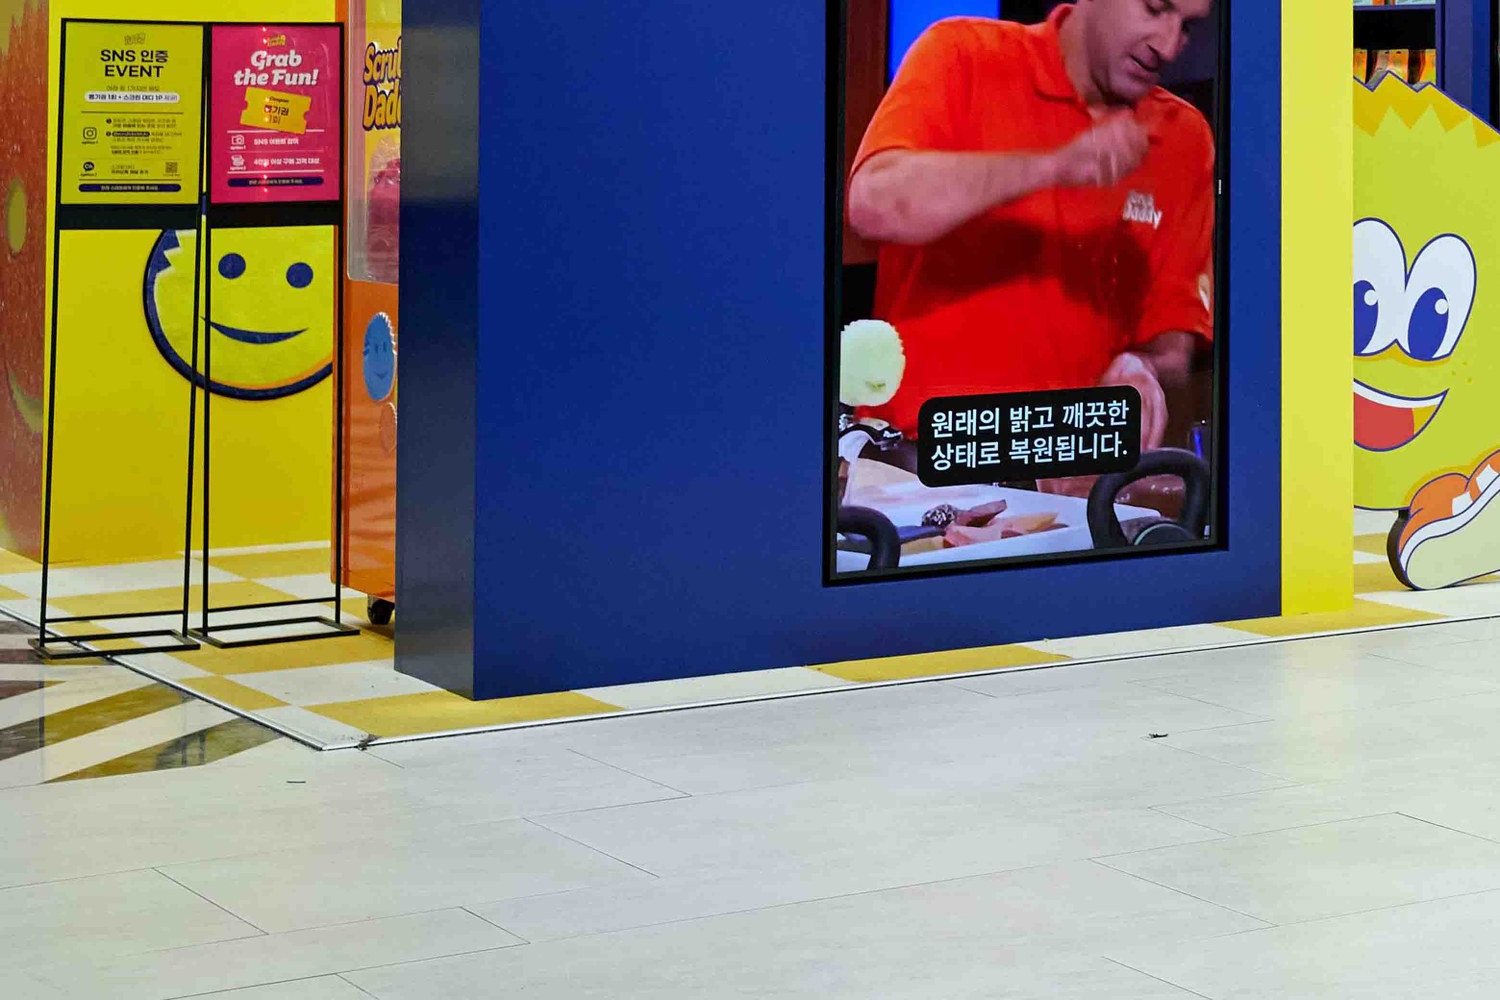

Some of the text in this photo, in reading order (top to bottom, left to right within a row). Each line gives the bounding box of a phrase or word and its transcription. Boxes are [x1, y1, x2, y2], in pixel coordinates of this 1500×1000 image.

[100, 49, 169, 63] SNS 인증
[250, 49, 302, 70] Grab
[104, 64, 164, 78] EVENT
[234, 68, 319, 86] the Fun!
[930, 398, 1130, 439] 원래의 밝고 깨끗한
[930, 432, 1129, 472] 상태로 복원됩니다.
